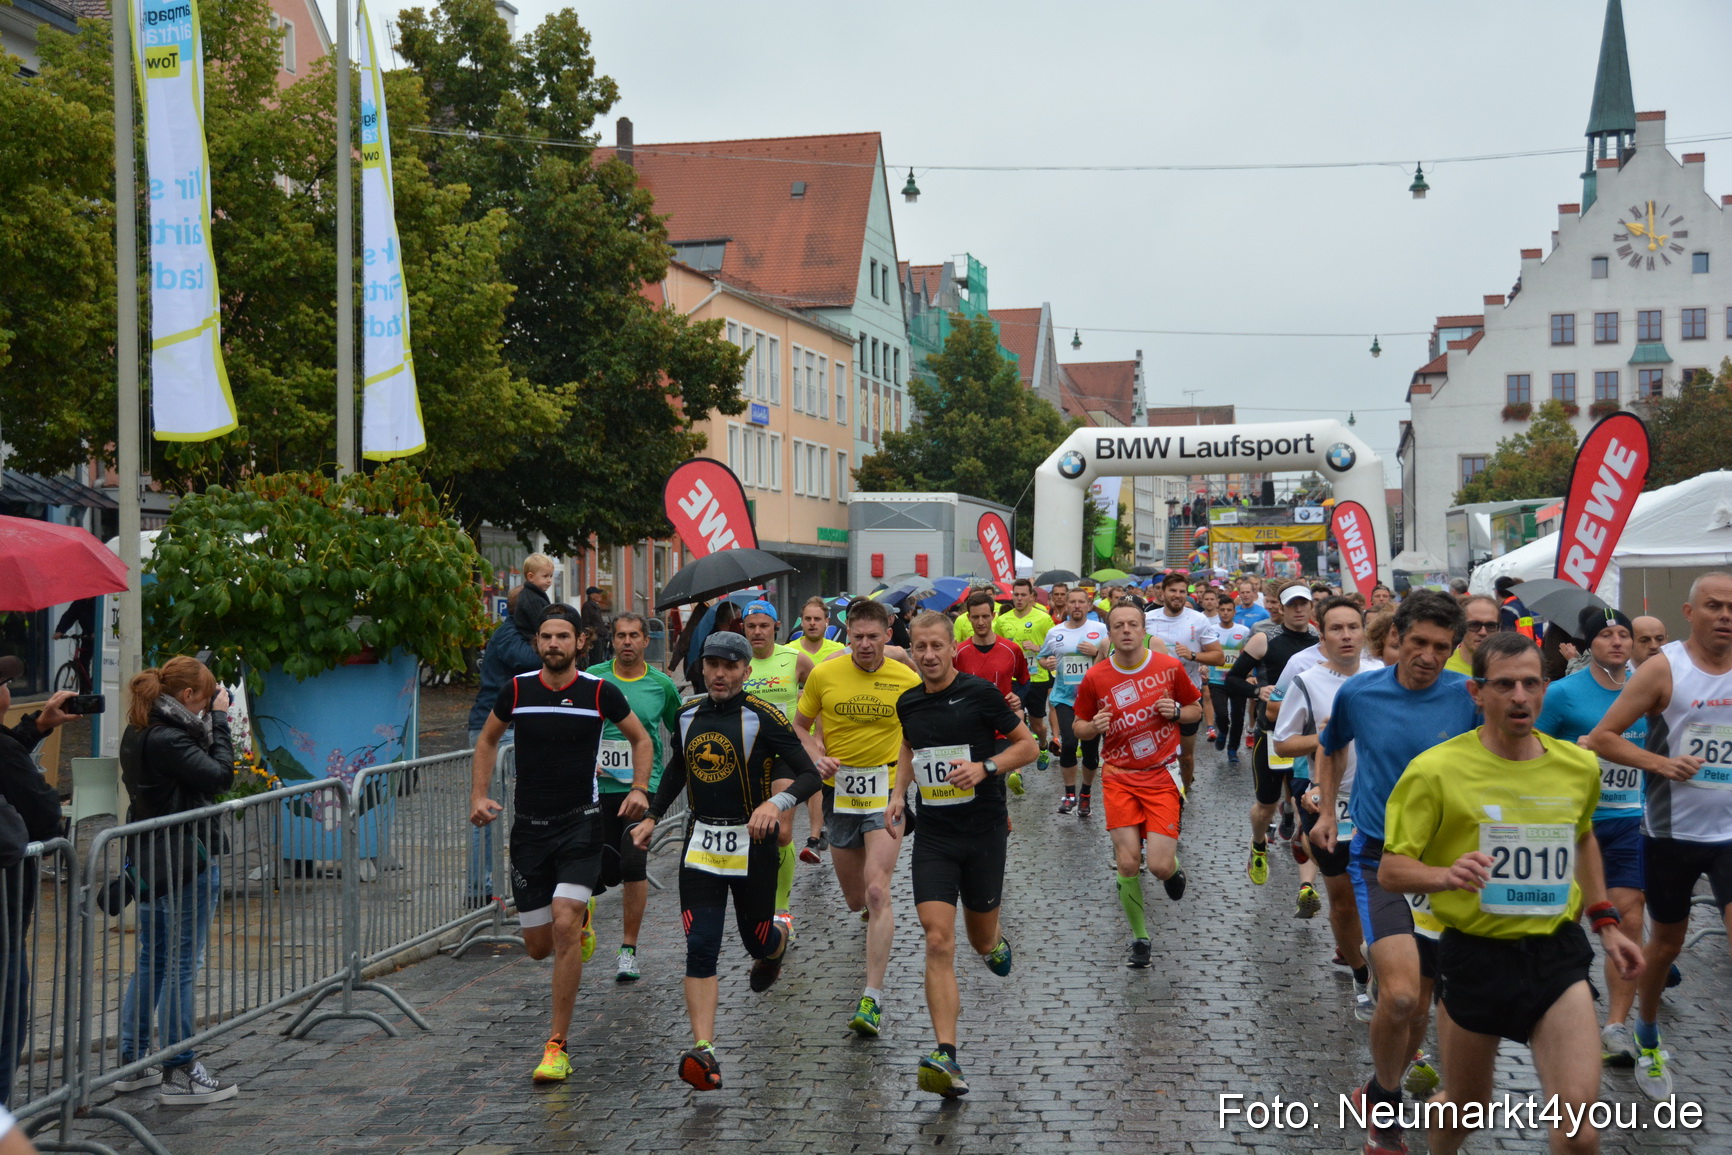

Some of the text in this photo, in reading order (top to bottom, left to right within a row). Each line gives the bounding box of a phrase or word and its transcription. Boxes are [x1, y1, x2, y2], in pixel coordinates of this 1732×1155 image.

[1096, 433, 1315, 461] BMW Laufsport
[1563, 437, 1638, 591] REWE
[1255, 529, 1281, 540] ZIEL
[500, 602, 508, 614] P
[1066, 662, 1090, 674] 2011
[841, 704, 888, 716] FRANCESCO
[690, 732, 733, 754] CONTINENTAL
[602, 750, 629, 767] 301
[690, 760, 734, 782] CONTINENTAL
[1704, 769, 1730, 780] Peter
[845, 775, 876, 795] 231
[932, 788, 955, 798] Albert
[851, 798, 872, 807] Oliver
[1525, 827, 1568, 838] BOCK
[702, 829, 737, 852] 618
[1491, 846, 1568, 880] 2010
[1507, 888, 1556, 903] Damian
